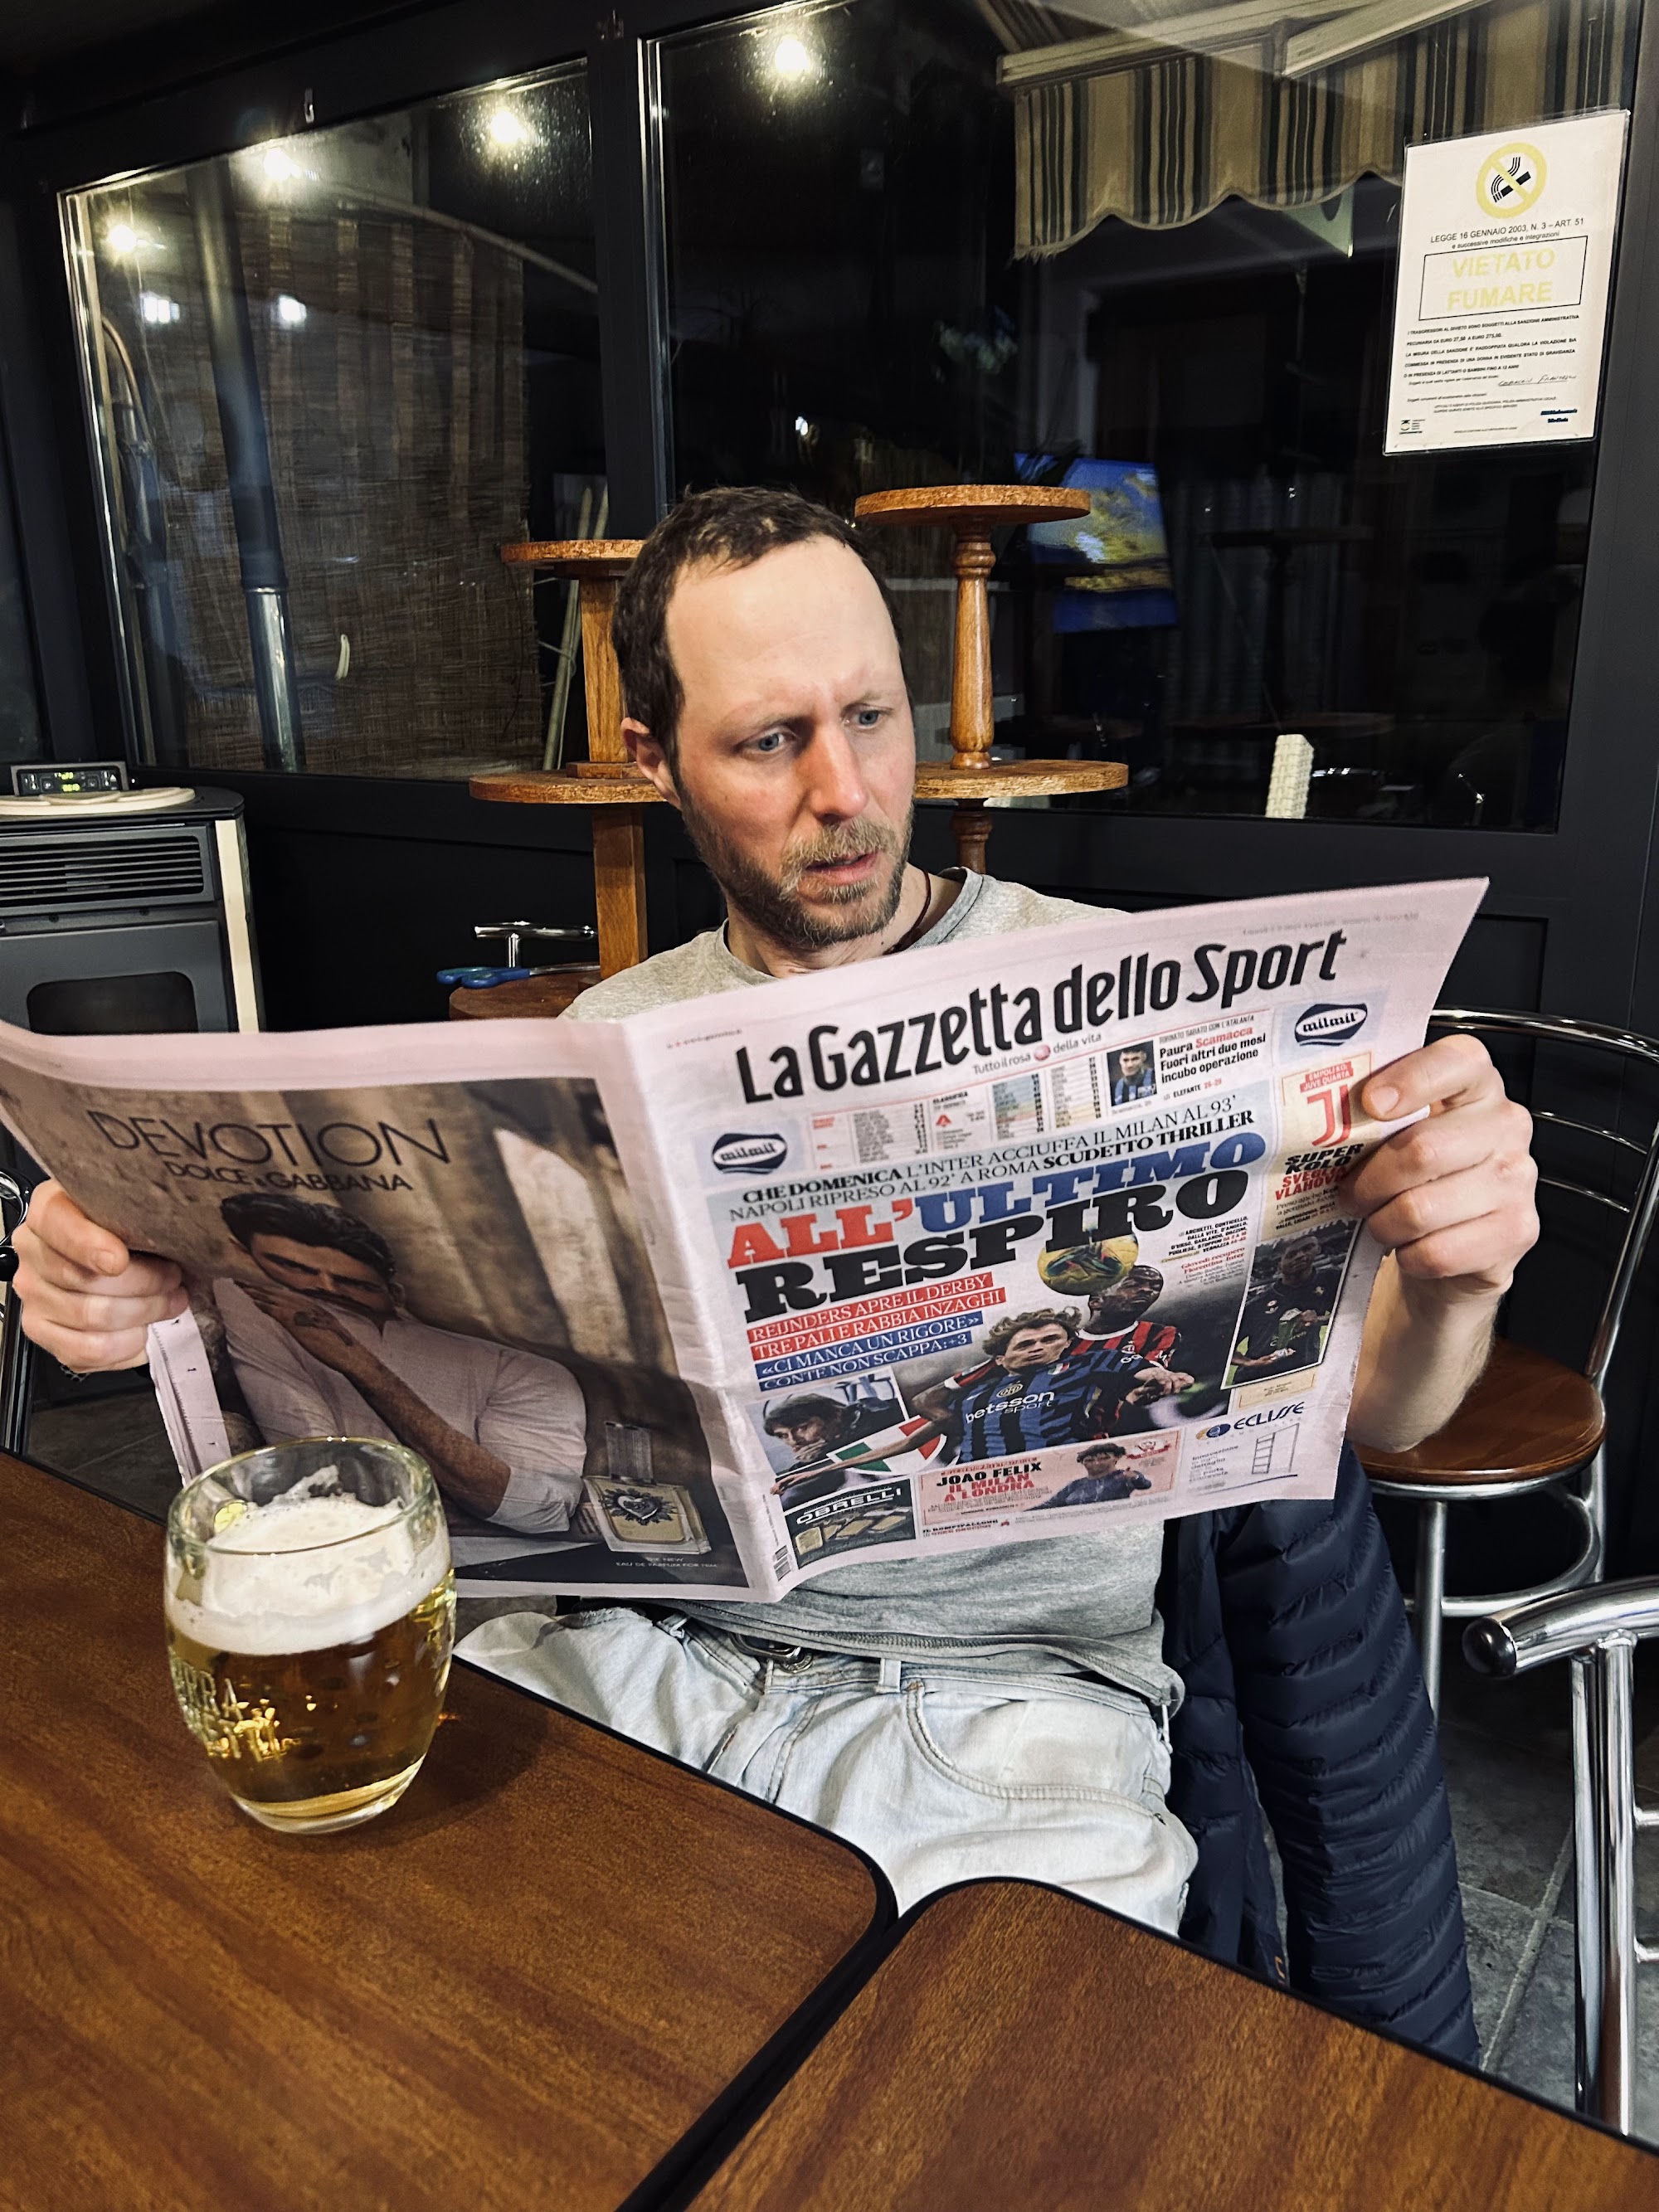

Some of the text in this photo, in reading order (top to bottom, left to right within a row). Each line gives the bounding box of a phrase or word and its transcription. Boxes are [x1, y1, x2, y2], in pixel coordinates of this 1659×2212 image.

[1431, 233, 1457, 243] LEGGE
[1470, 226, 1506, 238] GENNAIO
[1508, 225, 1529, 234] 2003,
[1574, 217, 1584, 226] 51
[1457, 239, 1489, 250] successive
[1490, 236, 1518, 245] modifiche
[1525, 231, 1559, 242] integrazioni
[1452, 248, 1555, 279] VIETATO
[1446, 281, 1554, 311] FUMARE
[736, 1045, 804, 1104] La
[808, 983, 1043, 1091] Gazzetta
[1053, 952, 1181, 1033] dello
[1186, 929, 1348, 1009] Sport
[1302, 1011, 1360, 1033] milmil
[972, 1033, 1102, 1075] Tutto il rosa della vita
[1160, 1027, 1253, 1058] Paura Scamacca
[1160, 1032, 1266, 1071] Fuori altri due mesi
[1161, 1049, 1258, 1083] incubo operazione
[1303, 1070, 1350, 1091] JUVE QUARTA
[1309, 1067, 1335, 1081] EMPOLI
[1173, 1084, 1201, 1098] ELEFANTE
[87, 1110, 451, 1167] DEVOTION
[719, 1142, 776, 1161] milmil
[743, 1183, 787, 1203] CHE
[790, 1167, 902, 1195] DOMENICA
[907, 1155, 984, 1177] L'INTER
[988, 1135, 1093, 1163] ACCIUFFA
[1094, 1130, 1112, 1144] IL
[1116, 1112, 1179, 1140] MILAN
[1184, 1105, 1209, 1123] AL
[1210, 1094, 1237, 1116] 93'
[1285, 1143, 1364, 1164] SUPER
[164, 1160, 252, 1186] DOLCE
[265, 1171, 414, 1193] GABBANA
[729, 1110, 1255, 1223] NAPOLI RIPRESO AL 92' A ROMA SCUDETTO THRILLER
[1285, 1156, 1351, 1175] KOLO
[727, 1132, 1266, 1269] ALL'ULTIMO
[736, 1169, 1248, 1324] RESPIRO
[1211, 1247, 1245, 1260] recupero
[856, 1295, 904, 1316] APRE
[906, 1291, 924, 1305] IL
[927, 1275, 989, 1300] DERBY
[754, 1290, 1003, 1359] TRE PALI E RABBIA INZAGHI
[762, 1317, 980, 1375] «CI MANCA UN RIGORE»
[764, 1368, 827, 1390] CONTE
[830, 1356, 870, 1376] NON
[873, 1341, 947, 1364] SCAPPA:
[965, 1391, 1055, 1424] betsson
[1004, 1400, 1053, 1414] sport
[1234, 1401, 1305, 1430] ECLISSE
[949, 1473, 1029, 1494] IL MILAN
[993, 1462, 1042, 1478] FELIX
[795, 1488, 902, 1525] OBRELLI
[944, 1494, 956, 1503] A
[961, 1480, 1034, 1499] LONDRA
